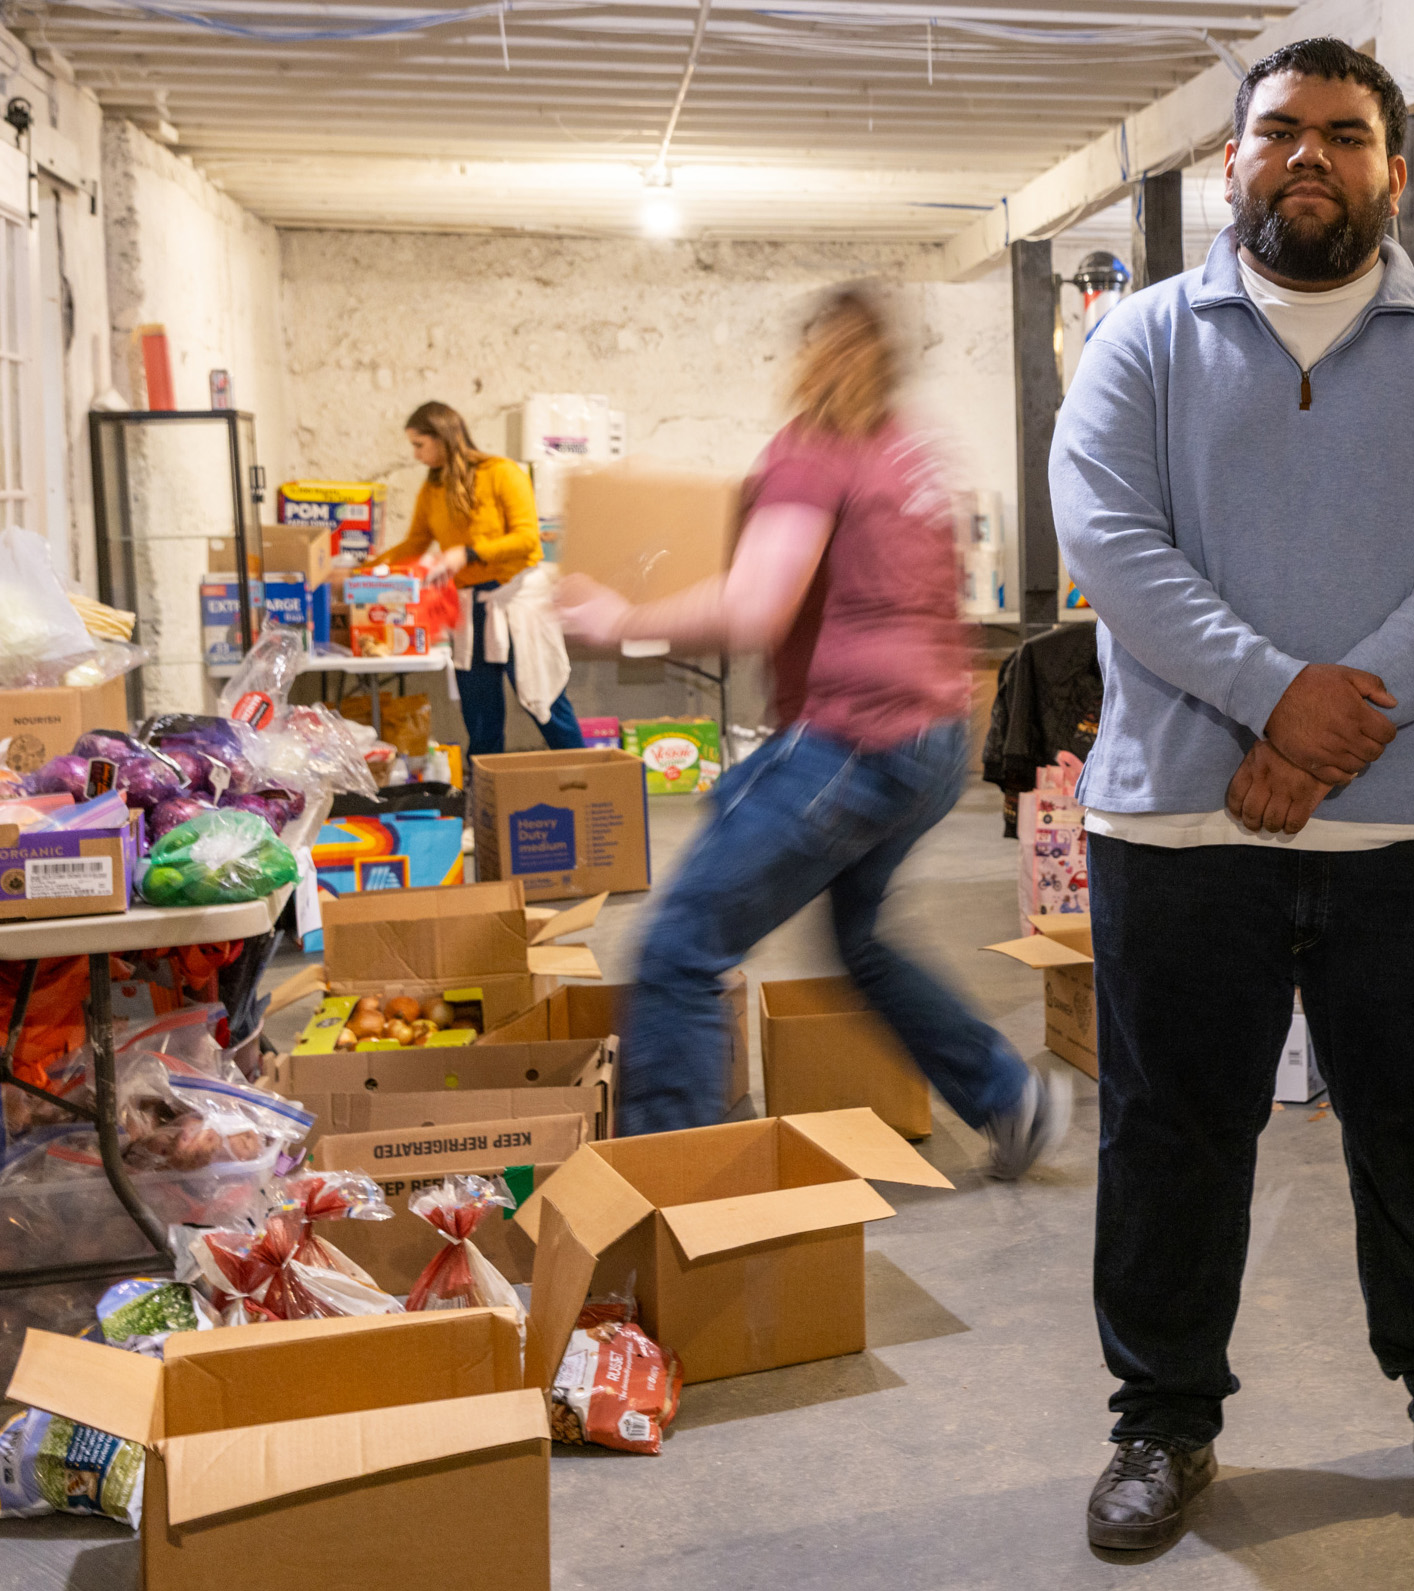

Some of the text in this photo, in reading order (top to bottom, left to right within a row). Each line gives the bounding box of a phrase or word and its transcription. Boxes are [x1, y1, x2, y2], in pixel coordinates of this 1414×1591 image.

[285, 502, 329, 520] POM
[264, 597, 301, 612] ARGE
[14, 716, 62, 726] NOURISH
[517, 818, 558, 830] Heavy
[518, 830, 549, 842] Duty
[0, 846, 65, 861] ORGANIC
[518, 840, 567, 853] medium
[374, 1131, 532, 1160] KEEP REFRIGERATED
